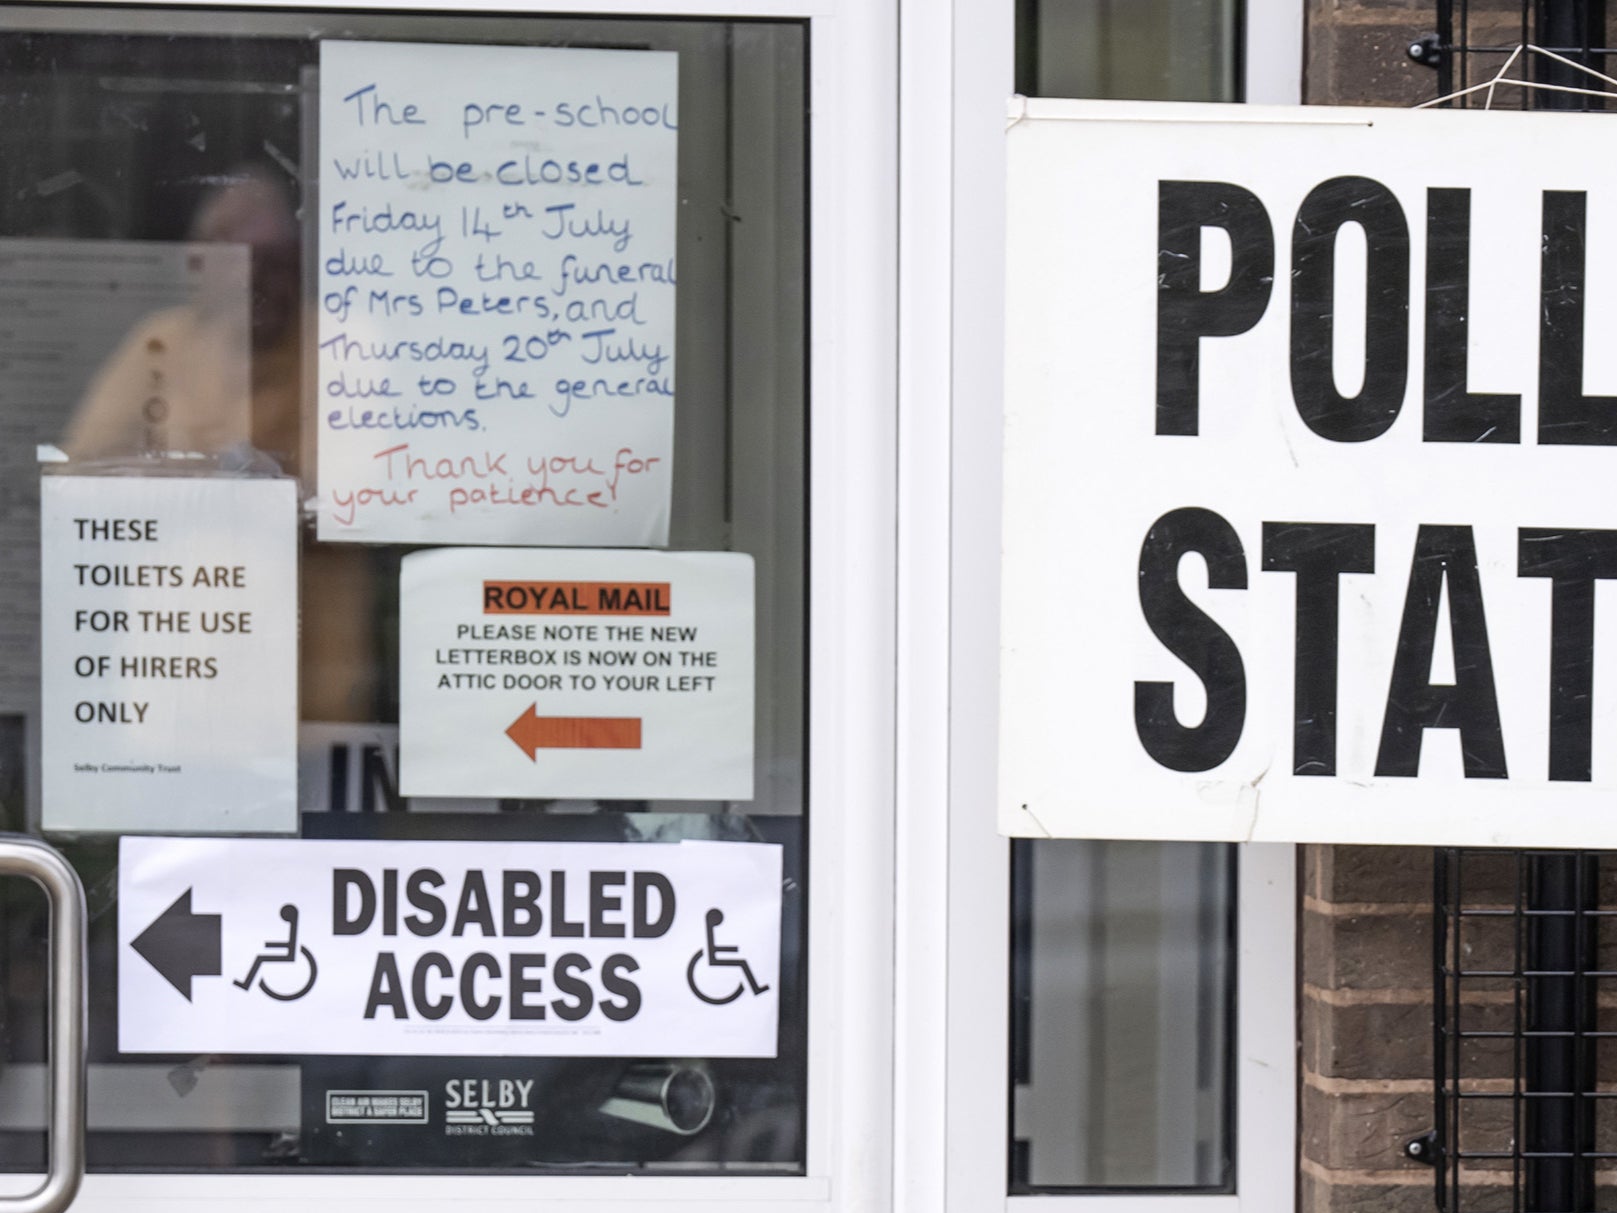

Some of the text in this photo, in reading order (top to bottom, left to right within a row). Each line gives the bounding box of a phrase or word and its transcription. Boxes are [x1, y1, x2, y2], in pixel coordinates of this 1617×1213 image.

[344, 84, 678, 139] The pre-school
[334, 151, 643, 186] will be closed
[332, 201, 634, 258] Friday 14th July
[325, 248, 677, 297] due to the funeral
[324, 286, 359, 323] of
[369, 290, 424, 316] Mrs
[565, 291, 647, 325] and
[320, 332, 490, 377] Thursday
[581, 328, 670, 375] July
[327, 374, 674, 418] due to the general
[328, 403, 487, 432] elections.
[374, 443, 661, 484] Thank you for
[333, 488, 419, 526] your
[74, 519, 158, 541] THESE
[74, 564, 246, 587] TOILETS ARE
[484, 586, 670, 611] ROYAL MAIL
[75, 610, 252, 633] FOR THE USE
[457, 624, 697, 641] PLEASE NOTE THE NEW
[75, 656, 218, 678] OF HIRERS
[436, 649, 717, 667] LETTERBOX IS NOW ON THE
[437, 674, 715, 691] ATTIC DOOR TO YOUR LEFT
[75, 702, 149, 723] ONLY
[332, 869, 676, 938] DISABLED
[363, 952, 642, 1021] ACCESS
[446, 1079, 534, 1108] SELBY
[446, 1126, 534, 1136] DISTRICT COUNCIL
